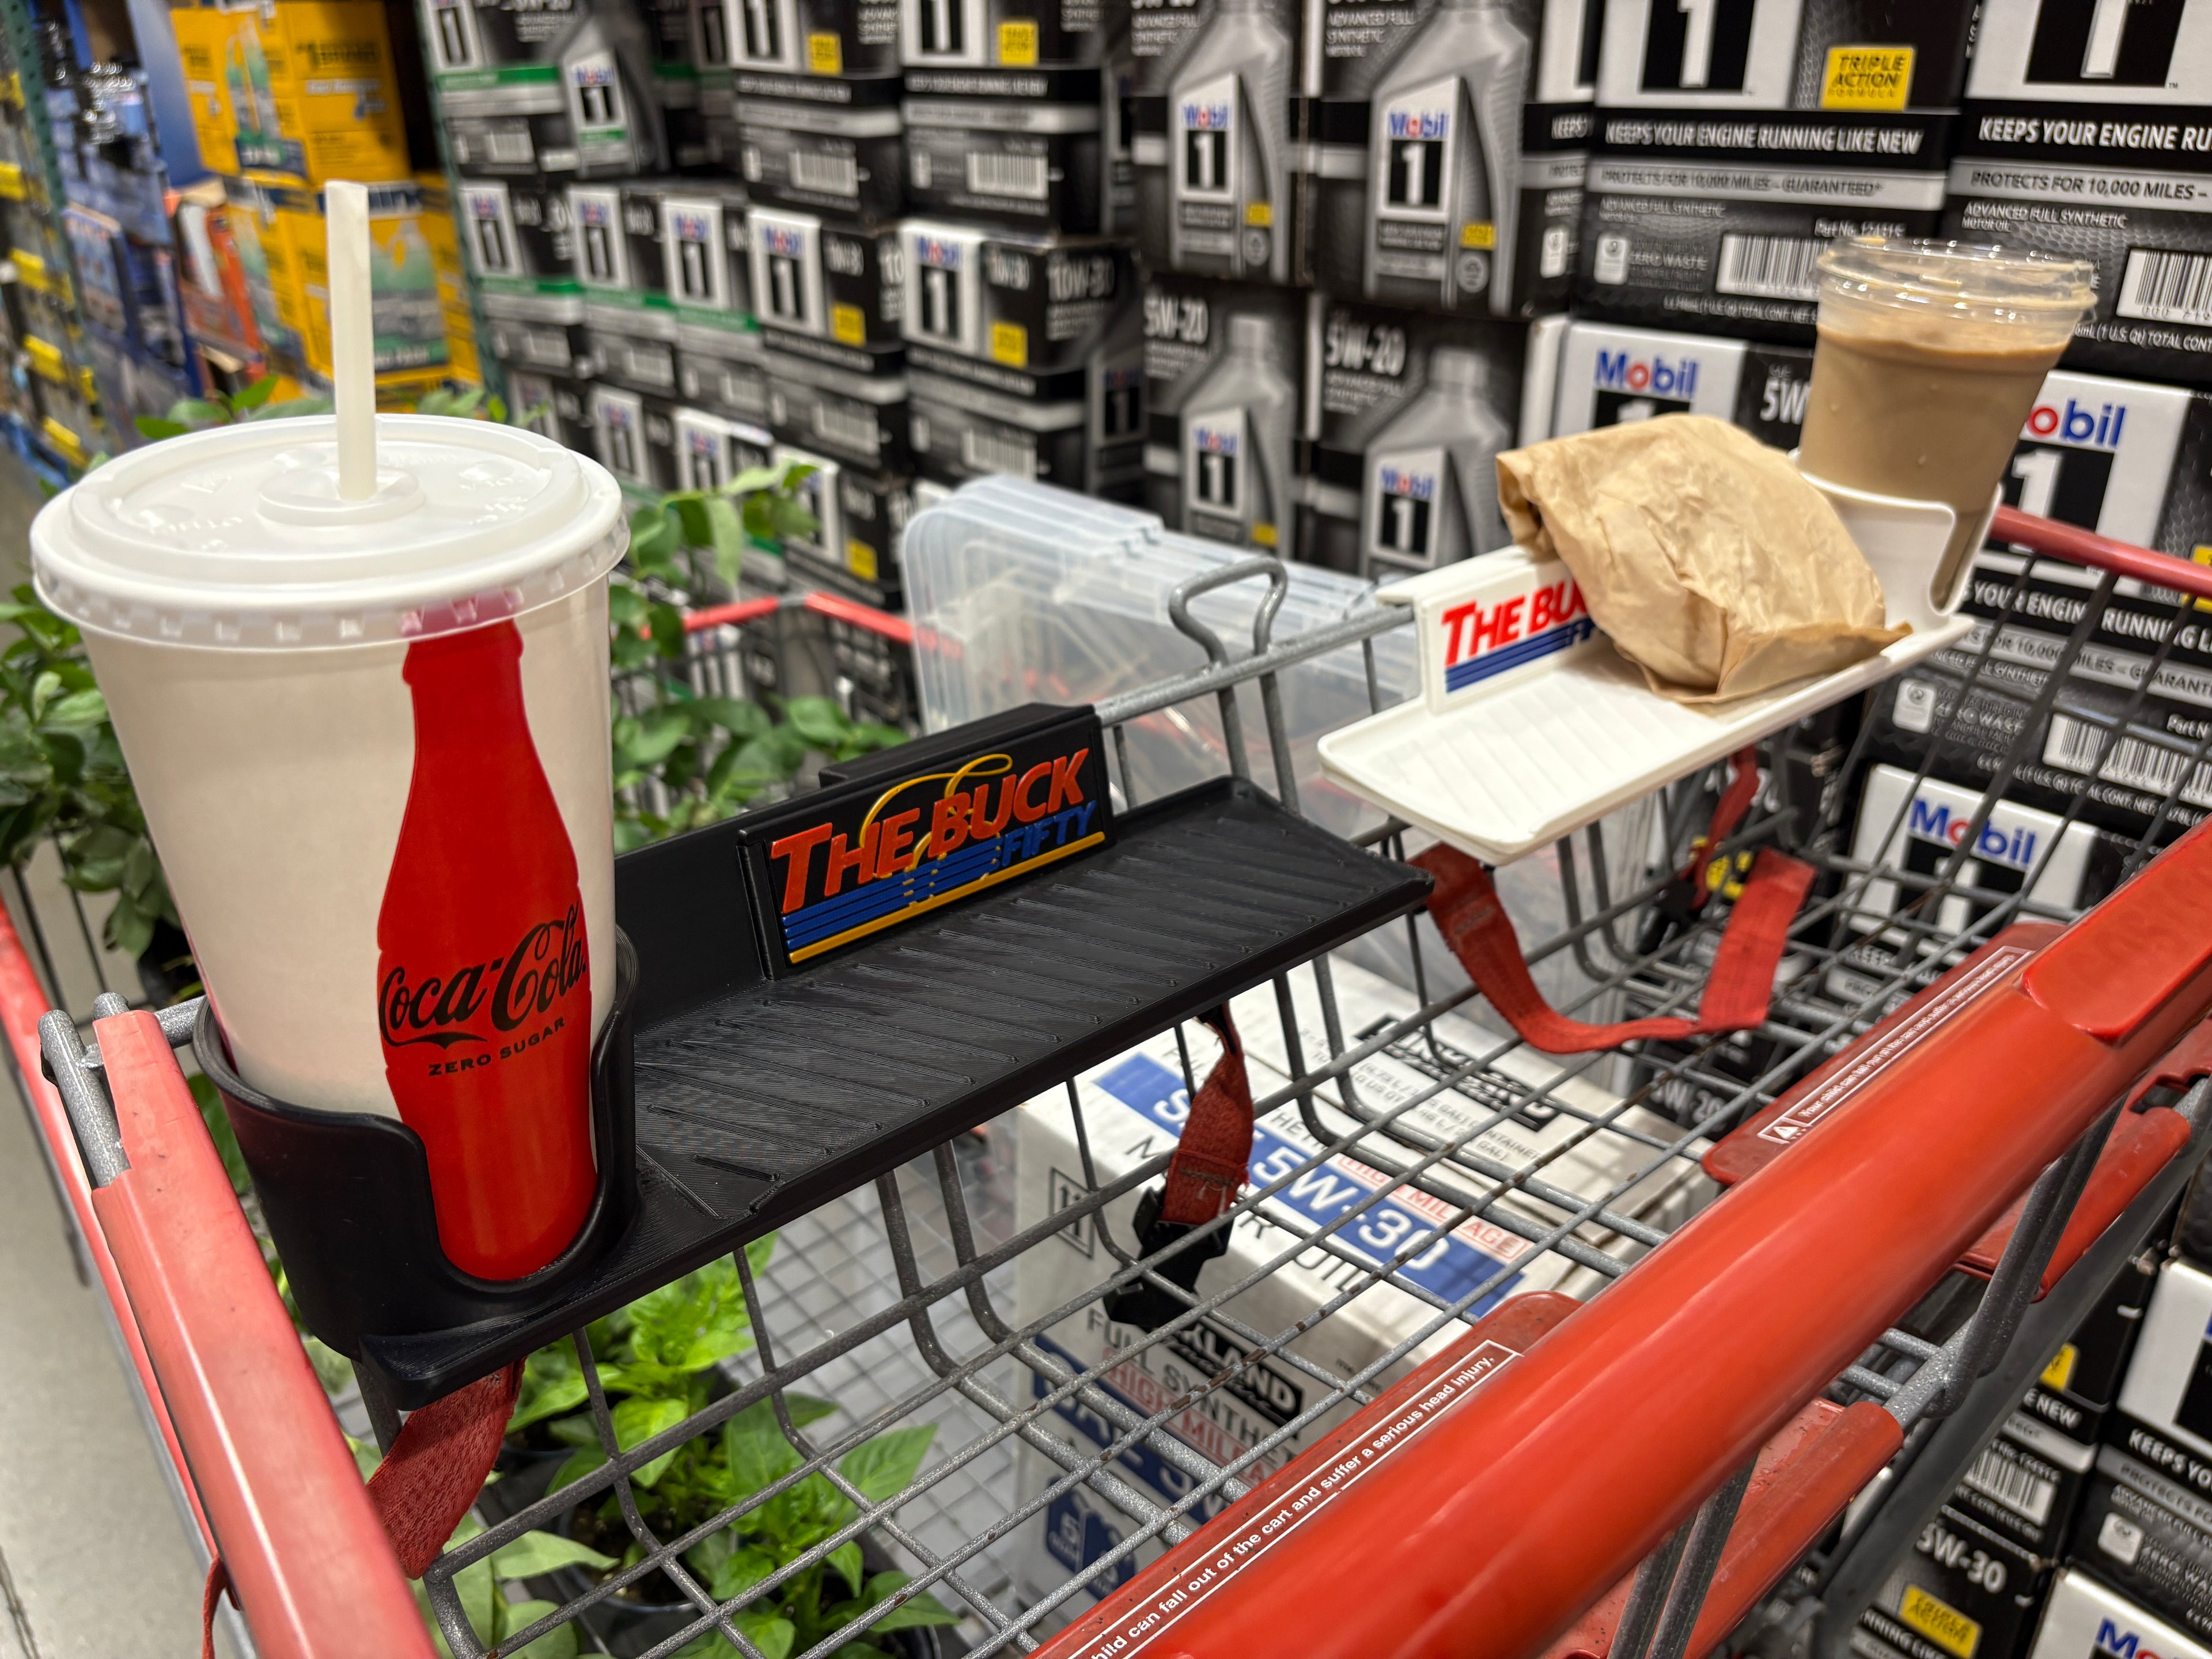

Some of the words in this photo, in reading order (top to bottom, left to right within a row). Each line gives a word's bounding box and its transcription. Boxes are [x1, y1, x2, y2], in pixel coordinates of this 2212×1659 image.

[1833, 73, 1899, 89] ACTION
[1838, 54, 1906, 71] TRIPLE
[1389, 112, 1450, 139] Mobil
[1605, 121, 1652, 145] KEEPS
[1653, 122, 1696, 147] YOUR
[1696, 123, 1757, 149] ENGINE
[1757, 125, 1836, 151] RUNNING
[1836, 128, 1876, 153] LIKE
[1877, 128, 1925, 155] NEW
[1978, 116, 2040, 144] KEEPS
[2043, 119, 2097, 147] YOUR
[2099, 122, 2177, 151] ENGINE
[1402, 143, 1426, 206] 1
[1970, 169, 2048, 191] PROTECTS
[2051, 174, 2083, 192] FOR
[2087, 177, 2138, 198] 10,000
[2142, 180, 2195, 200] MILES
[1963, 200, 2029, 222] ADVANCED
[2029, 205, 2059, 225] FULL
[2059, 208, 2128, 229] SYNTHETIC
[1595, 348, 1700, 399] Mobil
[2026, 397, 2128, 449] obil
[1441, 594, 1525, 668] THE
[1527, 578, 1590, 638] BU
[2025, 590, 2088, 624] ENGIN
[771, 806, 921, 914] THE
[927, 748, 1090, 858] BUCK
[1001, 800, 1096, 868] FIFTY
[379, 900, 586, 1047] Coca-Cola
[428, 1054, 492, 1077] ZERO
[499, 1016, 565, 1060] SUGAR
[2036, 1393, 2083, 1430] NEW
[2129, 1427, 2188, 1475] KEEPS
[1090, 1635, 1128, 1659] hild
[1128, 1612, 1161, 1638] can
[1158, 1588, 1188, 1613] fall
[1188, 1568, 1217, 1592] out
[1217, 1551, 1236, 1569] of
[1233, 1531, 1262, 1555] the
[1262, 1507, 1293, 1535] cart
[1291, 1486, 1321, 1513] and
[1320, 1454, 1361, 1490] suffer
[1362, 1446, 1374, 1459] a
[1372, 1408, 1423, 1449] serious
[1425, 1384, 1455, 1414] head
[1450, 1355, 1495, 1389] injury.
